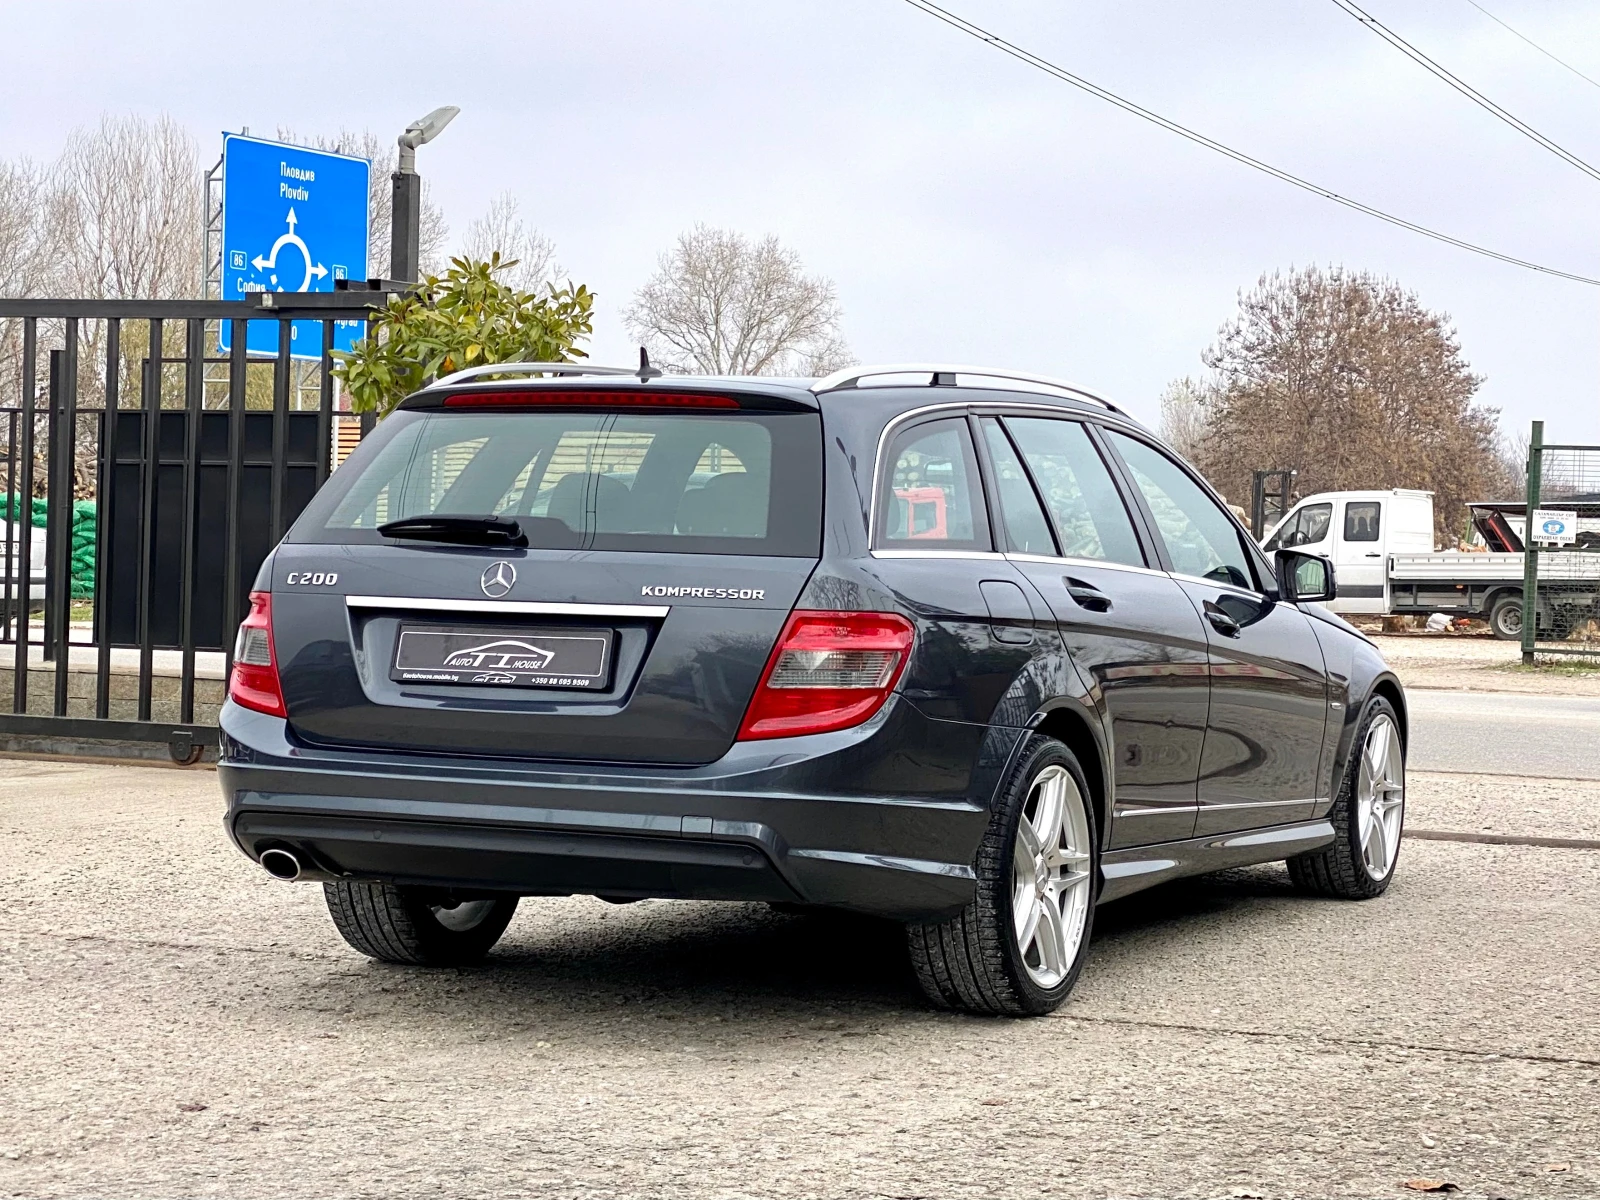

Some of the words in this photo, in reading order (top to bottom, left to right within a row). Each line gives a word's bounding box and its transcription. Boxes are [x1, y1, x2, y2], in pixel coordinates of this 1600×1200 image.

[280, 161, 315, 182] Пловдив
[280, 182, 309, 202] Plovdiv
[233, 254, 244, 267] 86
[335, 268, 345, 280] 86
[237, 277, 266, 293] София
[286, 572, 299, 585] C
[299, 572, 338, 586] 200
[641, 585, 765, 600] KOMPRESSOR
[449, 657, 473, 667] AUTO
[511, 660, 543, 669] HOUSE
